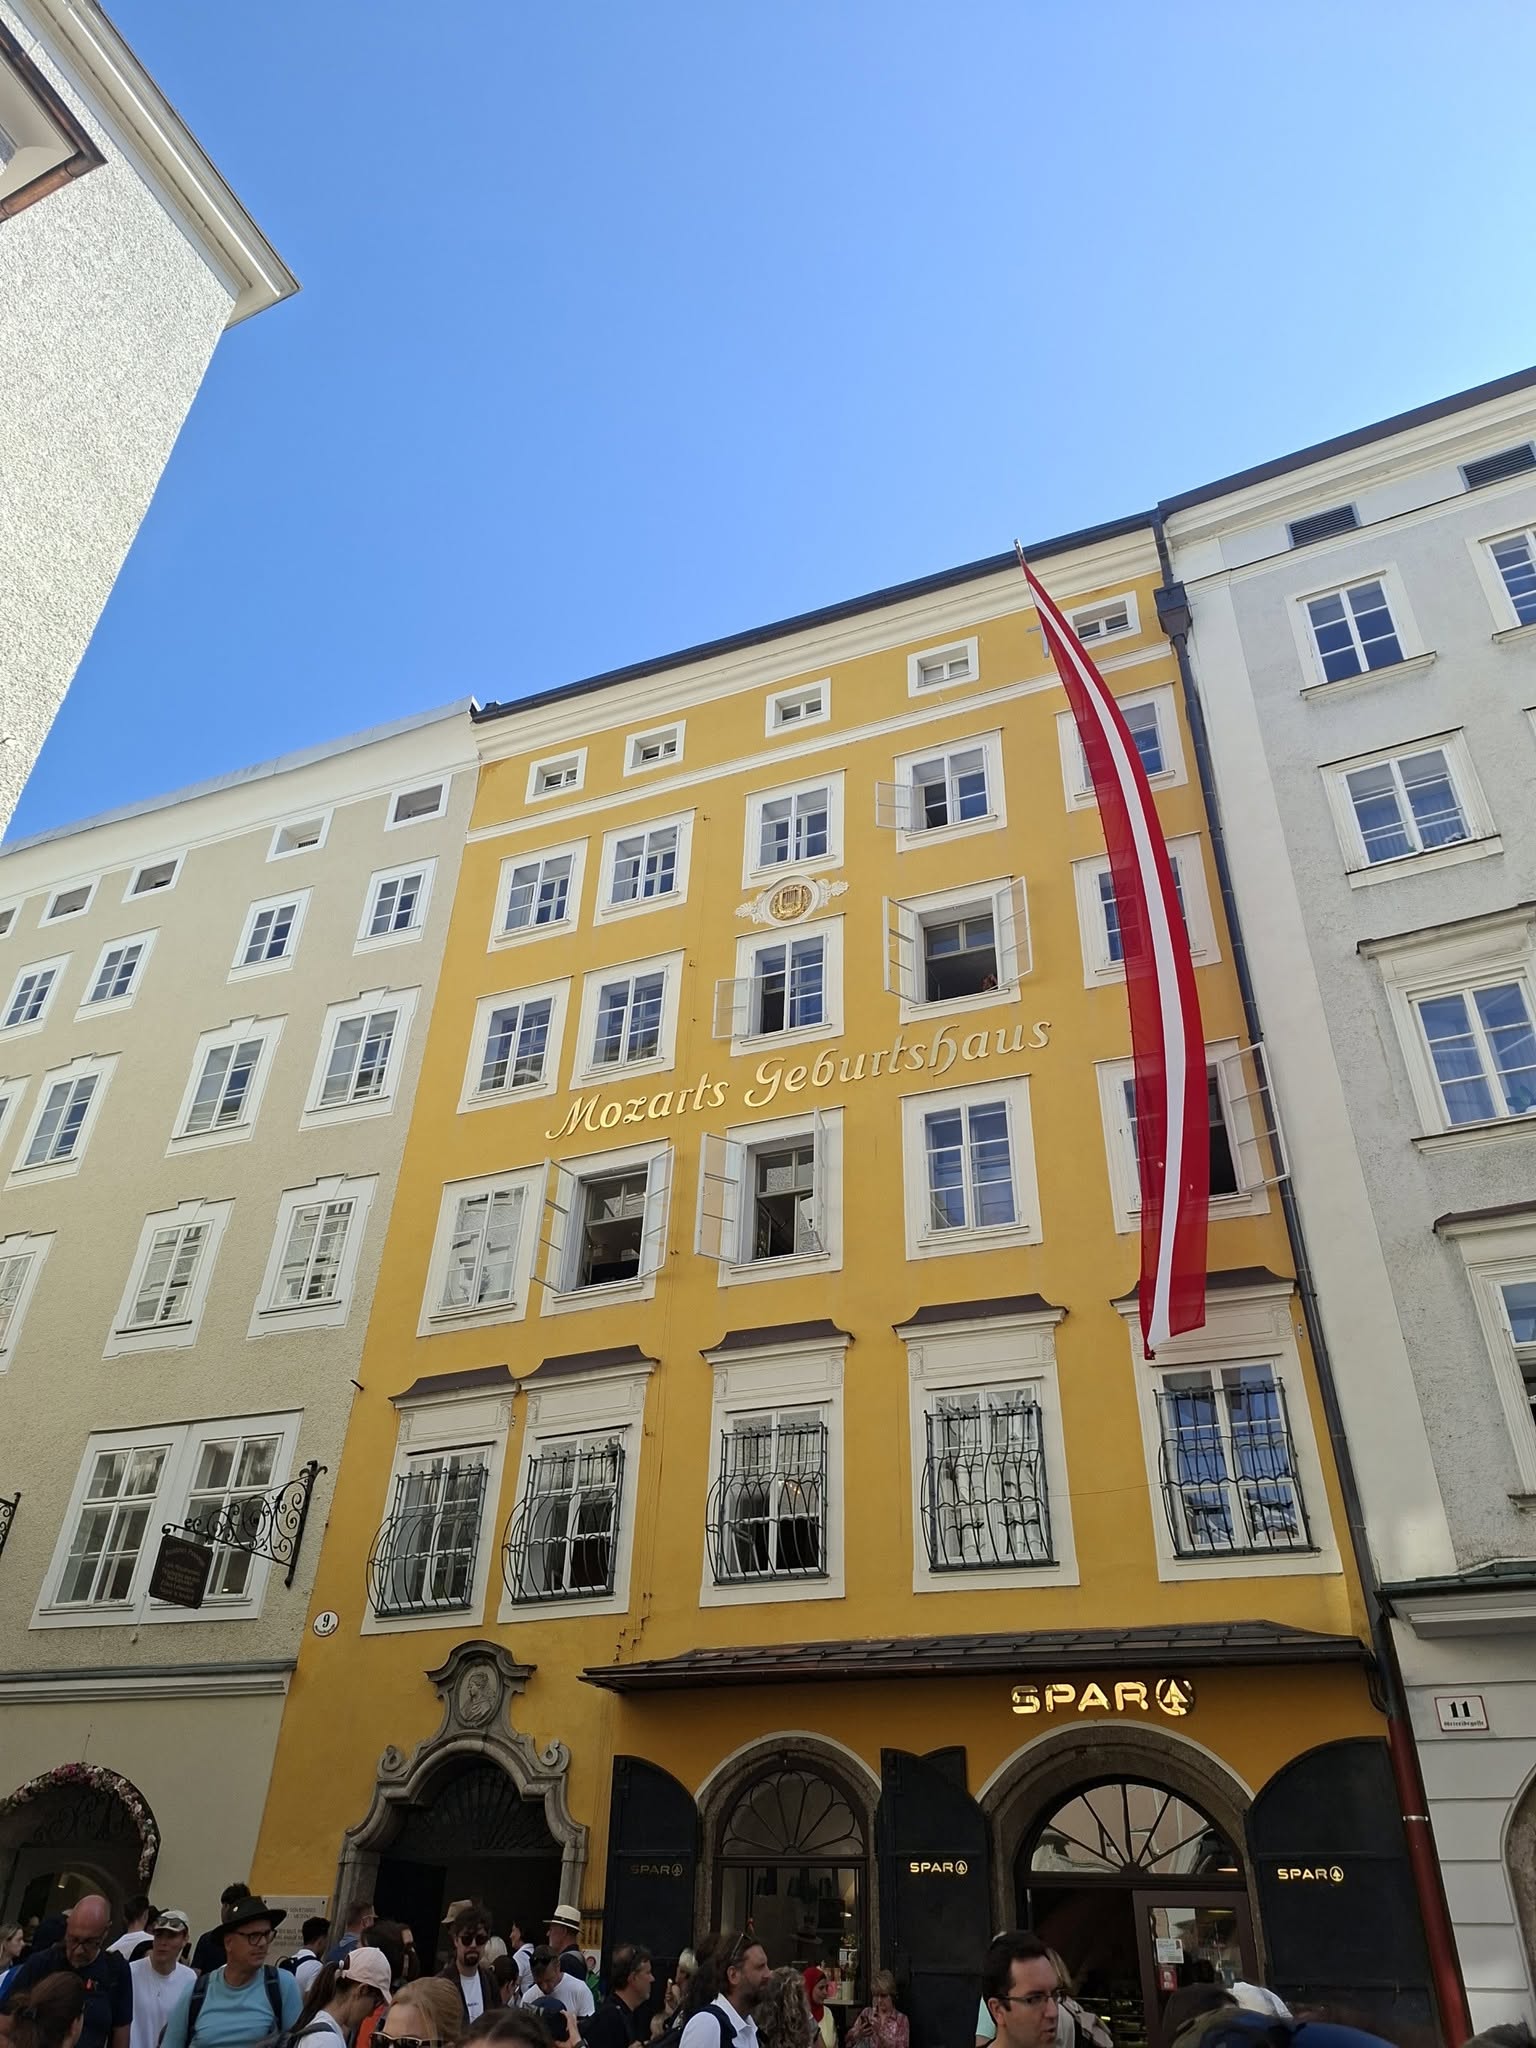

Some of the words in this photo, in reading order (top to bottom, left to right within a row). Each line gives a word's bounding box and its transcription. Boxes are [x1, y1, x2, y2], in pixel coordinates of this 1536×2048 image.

[545, 1072, 730, 1140] Mozarts
[744, 1021, 1052, 1107] Geburtshaus
[322, 1614, 330, 1628] 9
[1012, 1681, 1148, 1714] SPAR
[1449, 1701, 1471, 1718] 11
[630, 1864, 670, 1874] SPAR
[910, 1862, 953, 1873] SPAR
[1277, 1868, 1328, 1880] SPAR
